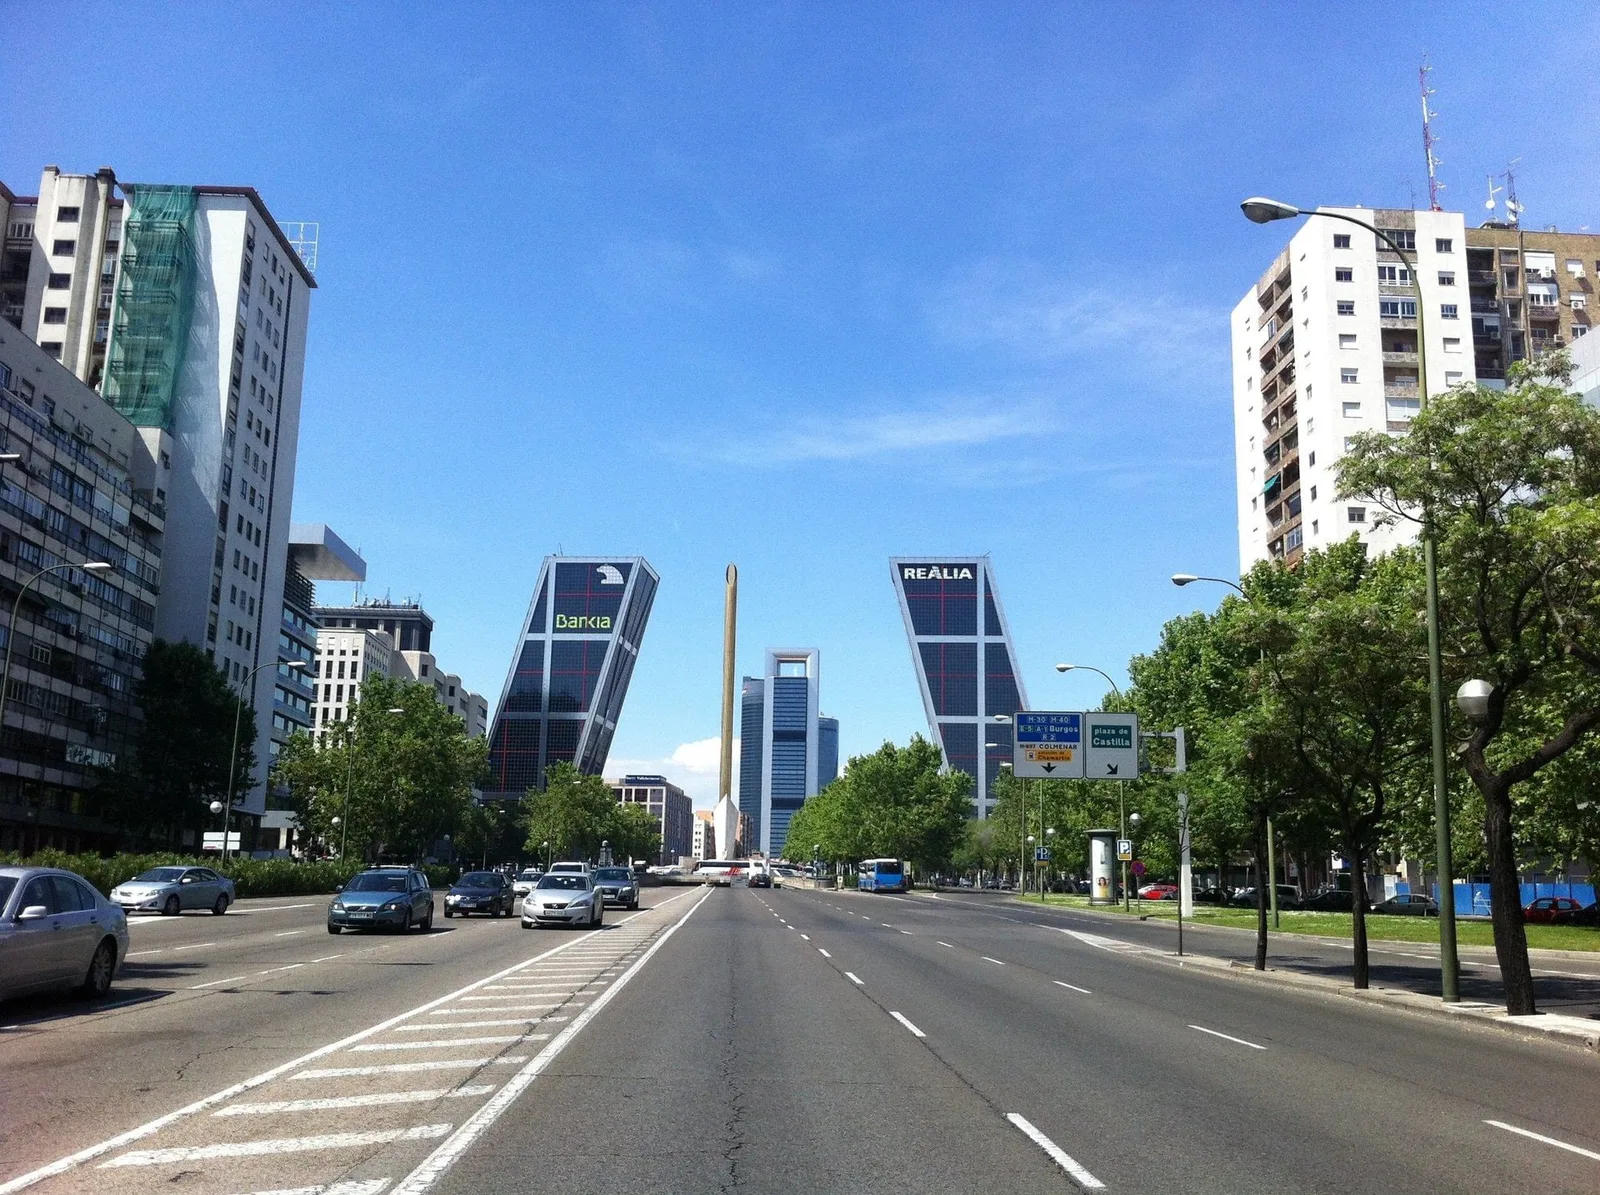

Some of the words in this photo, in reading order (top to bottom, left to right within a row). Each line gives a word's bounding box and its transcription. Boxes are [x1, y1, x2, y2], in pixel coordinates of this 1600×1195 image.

[904, 566, 973, 580] REALIA
[556, 614, 611, 629] Bankia
[1049, 725, 1078, 733] Burgos
[1118, 727, 1128, 735] de
[1092, 737, 1131, 747] Castilla
